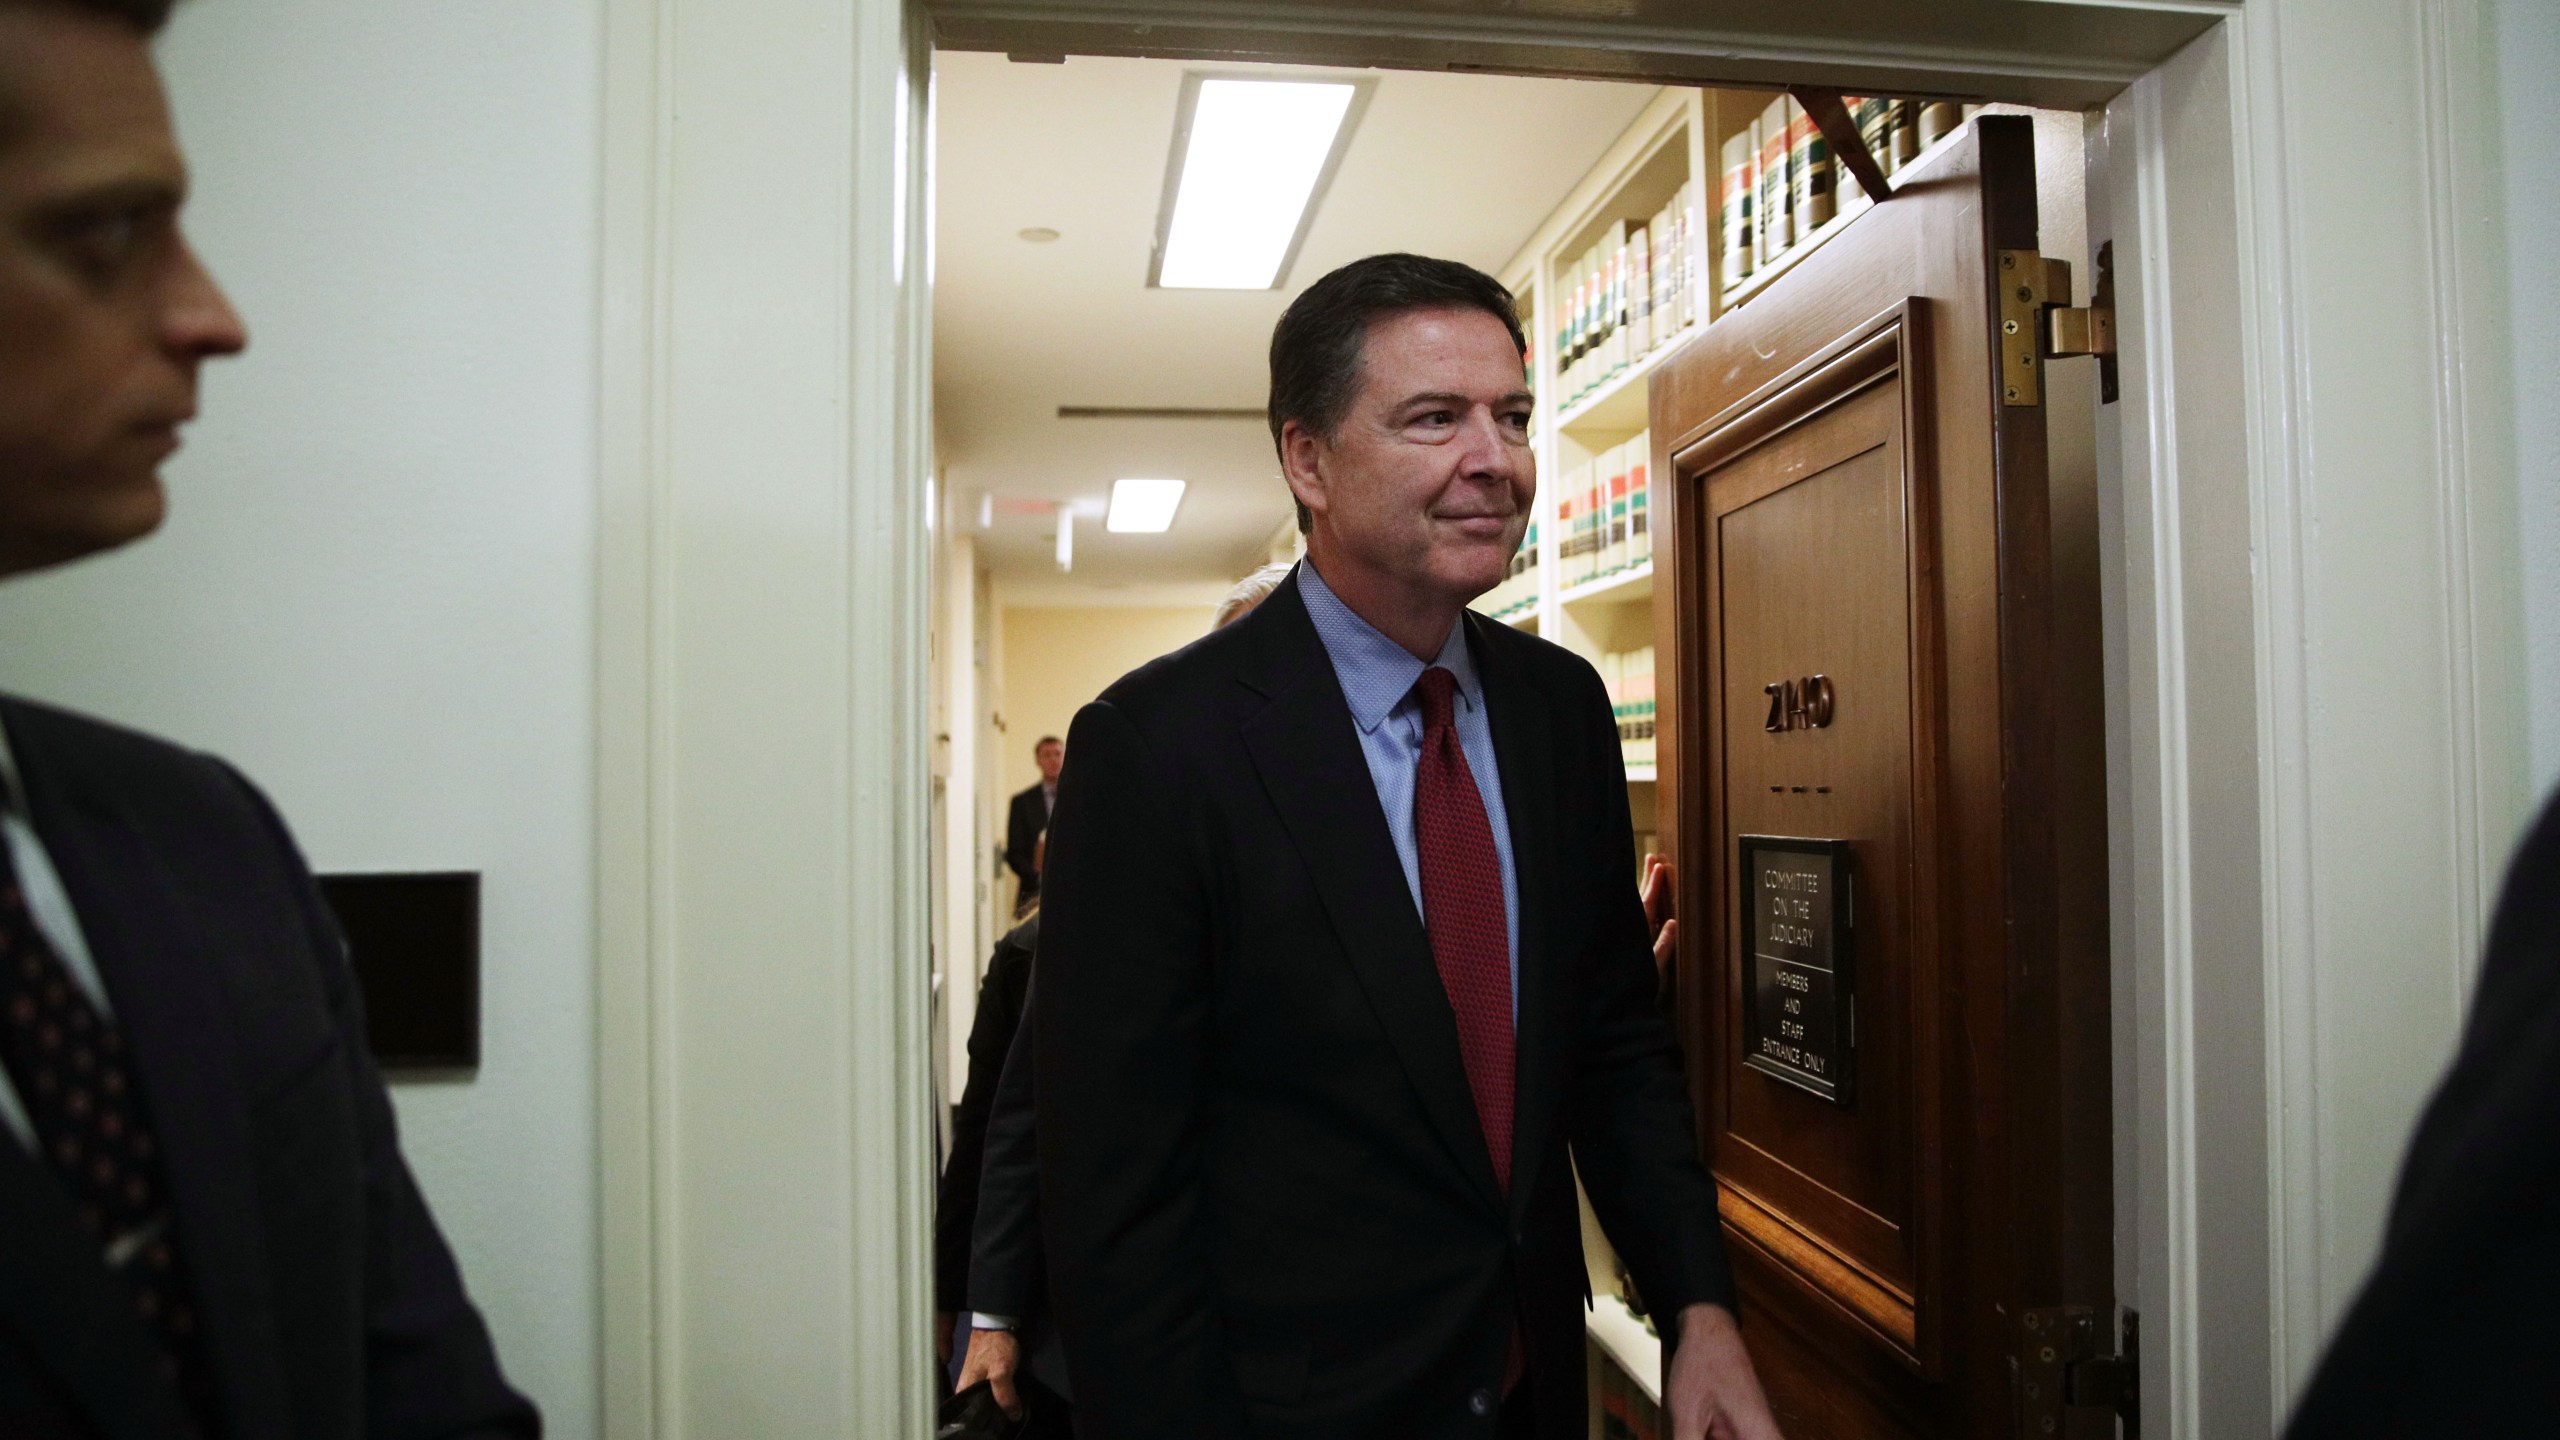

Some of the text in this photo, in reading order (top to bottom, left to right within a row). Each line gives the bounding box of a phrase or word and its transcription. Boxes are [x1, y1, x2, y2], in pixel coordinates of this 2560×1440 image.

[1764, 674, 1835, 733] 2140
[1765, 870, 1818, 893] COMMITTEE
[1773, 896, 1809, 920] ON THE
[1770, 922, 1813, 947] JUDICIARY
[1776, 970, 1809, 992] MEMBERS
[1785, 998, 1801, 1014] AND
[1782, 1020, 1804, 1040] STAFF
[1763, 1038, 1825, 1073] ENTRANCE ONLY
